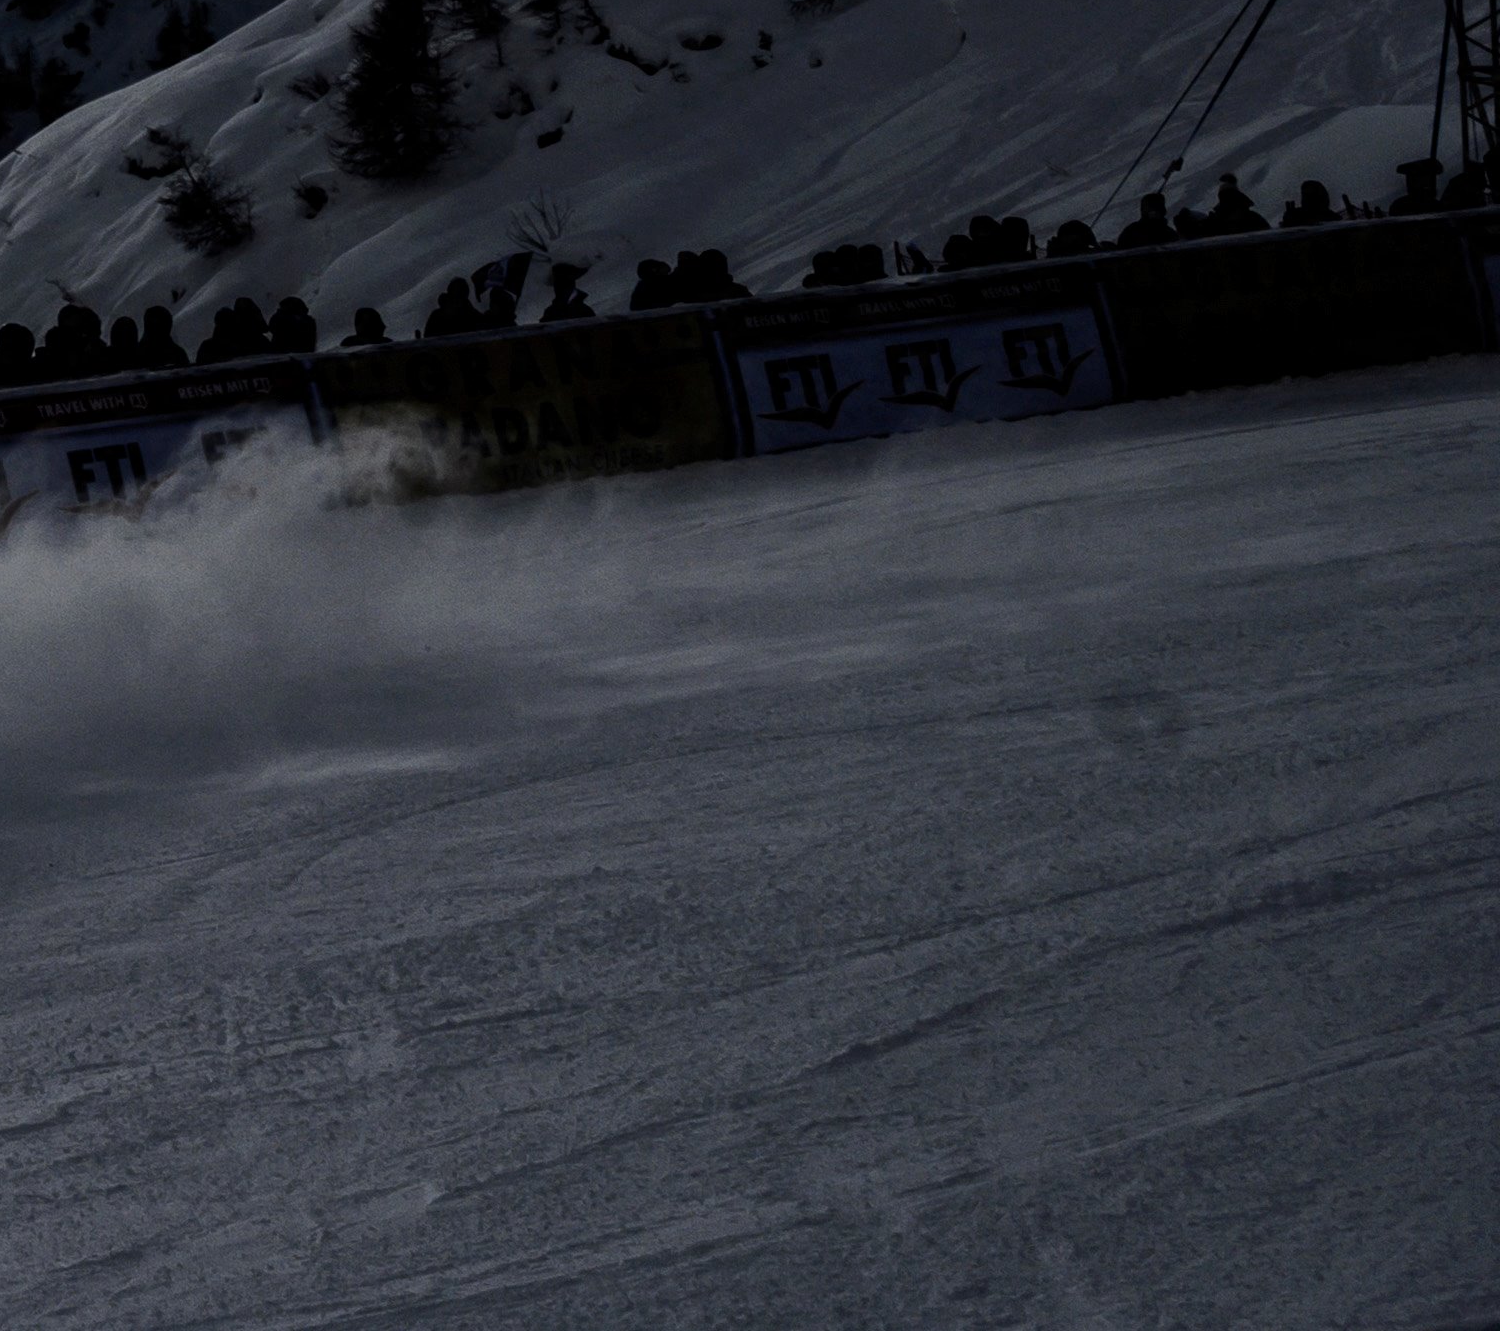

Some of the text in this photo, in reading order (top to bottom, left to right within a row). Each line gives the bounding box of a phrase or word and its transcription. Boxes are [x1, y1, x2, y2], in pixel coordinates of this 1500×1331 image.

[745, 315, 788, 328] REISEN
[886, 338, 956, 397] FTI
[1002, 323, 1070, 379] FTI
[37, 400, 85, 420] TRAVEL
[88, 394, 125, 412] WITH
[178, 382, 223, 399] REISEN
[226, 378, 250, 395] MIT
[764, 353, 837, 413] FTI
[66, 442, 147, 503] FTI
